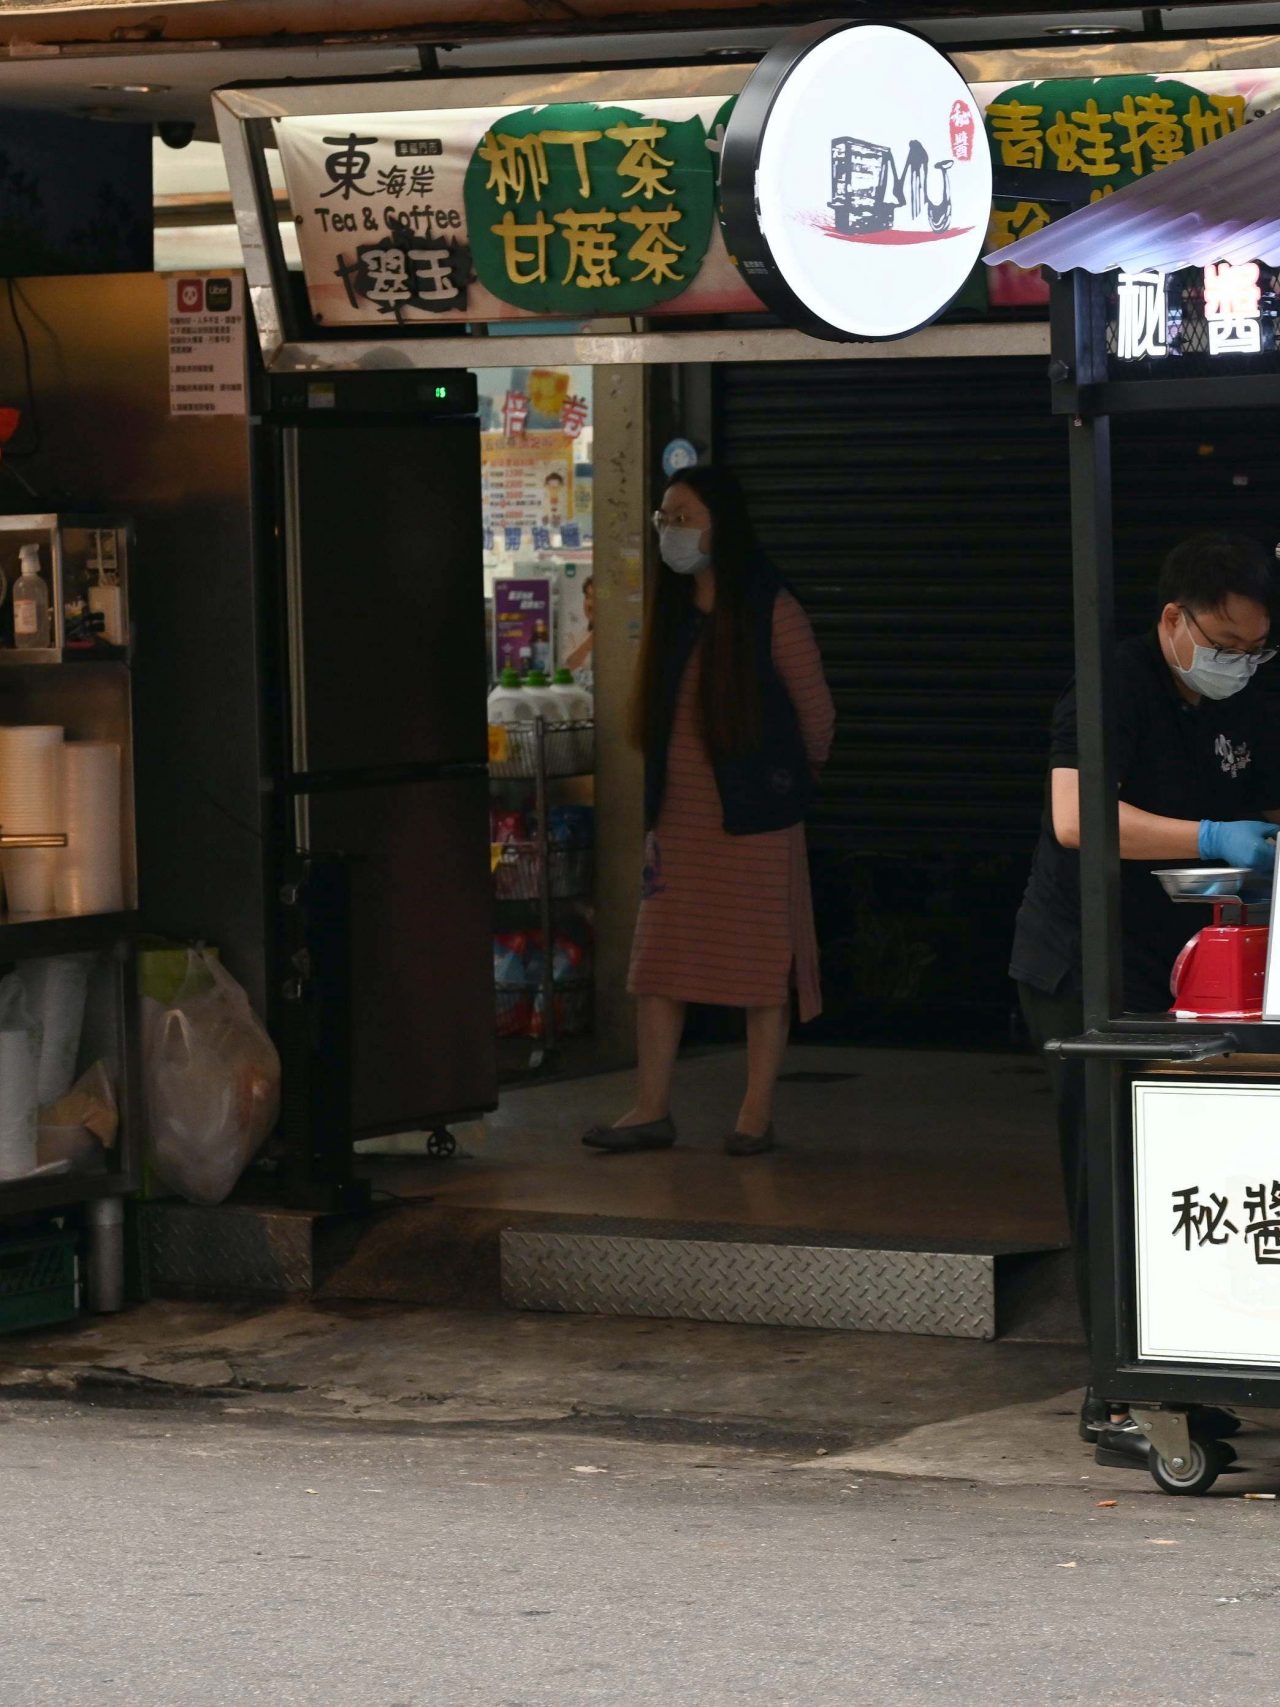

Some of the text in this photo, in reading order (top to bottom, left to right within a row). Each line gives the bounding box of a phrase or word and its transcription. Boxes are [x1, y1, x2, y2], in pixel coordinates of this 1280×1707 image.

[479, 120, 676, 205] 柳丁茶
[314, 204, 462, 233] Tea & Coffee
[490, 203, 685, 288] 甘蔗茶
[360, 248, 459, 308] 翠玉
